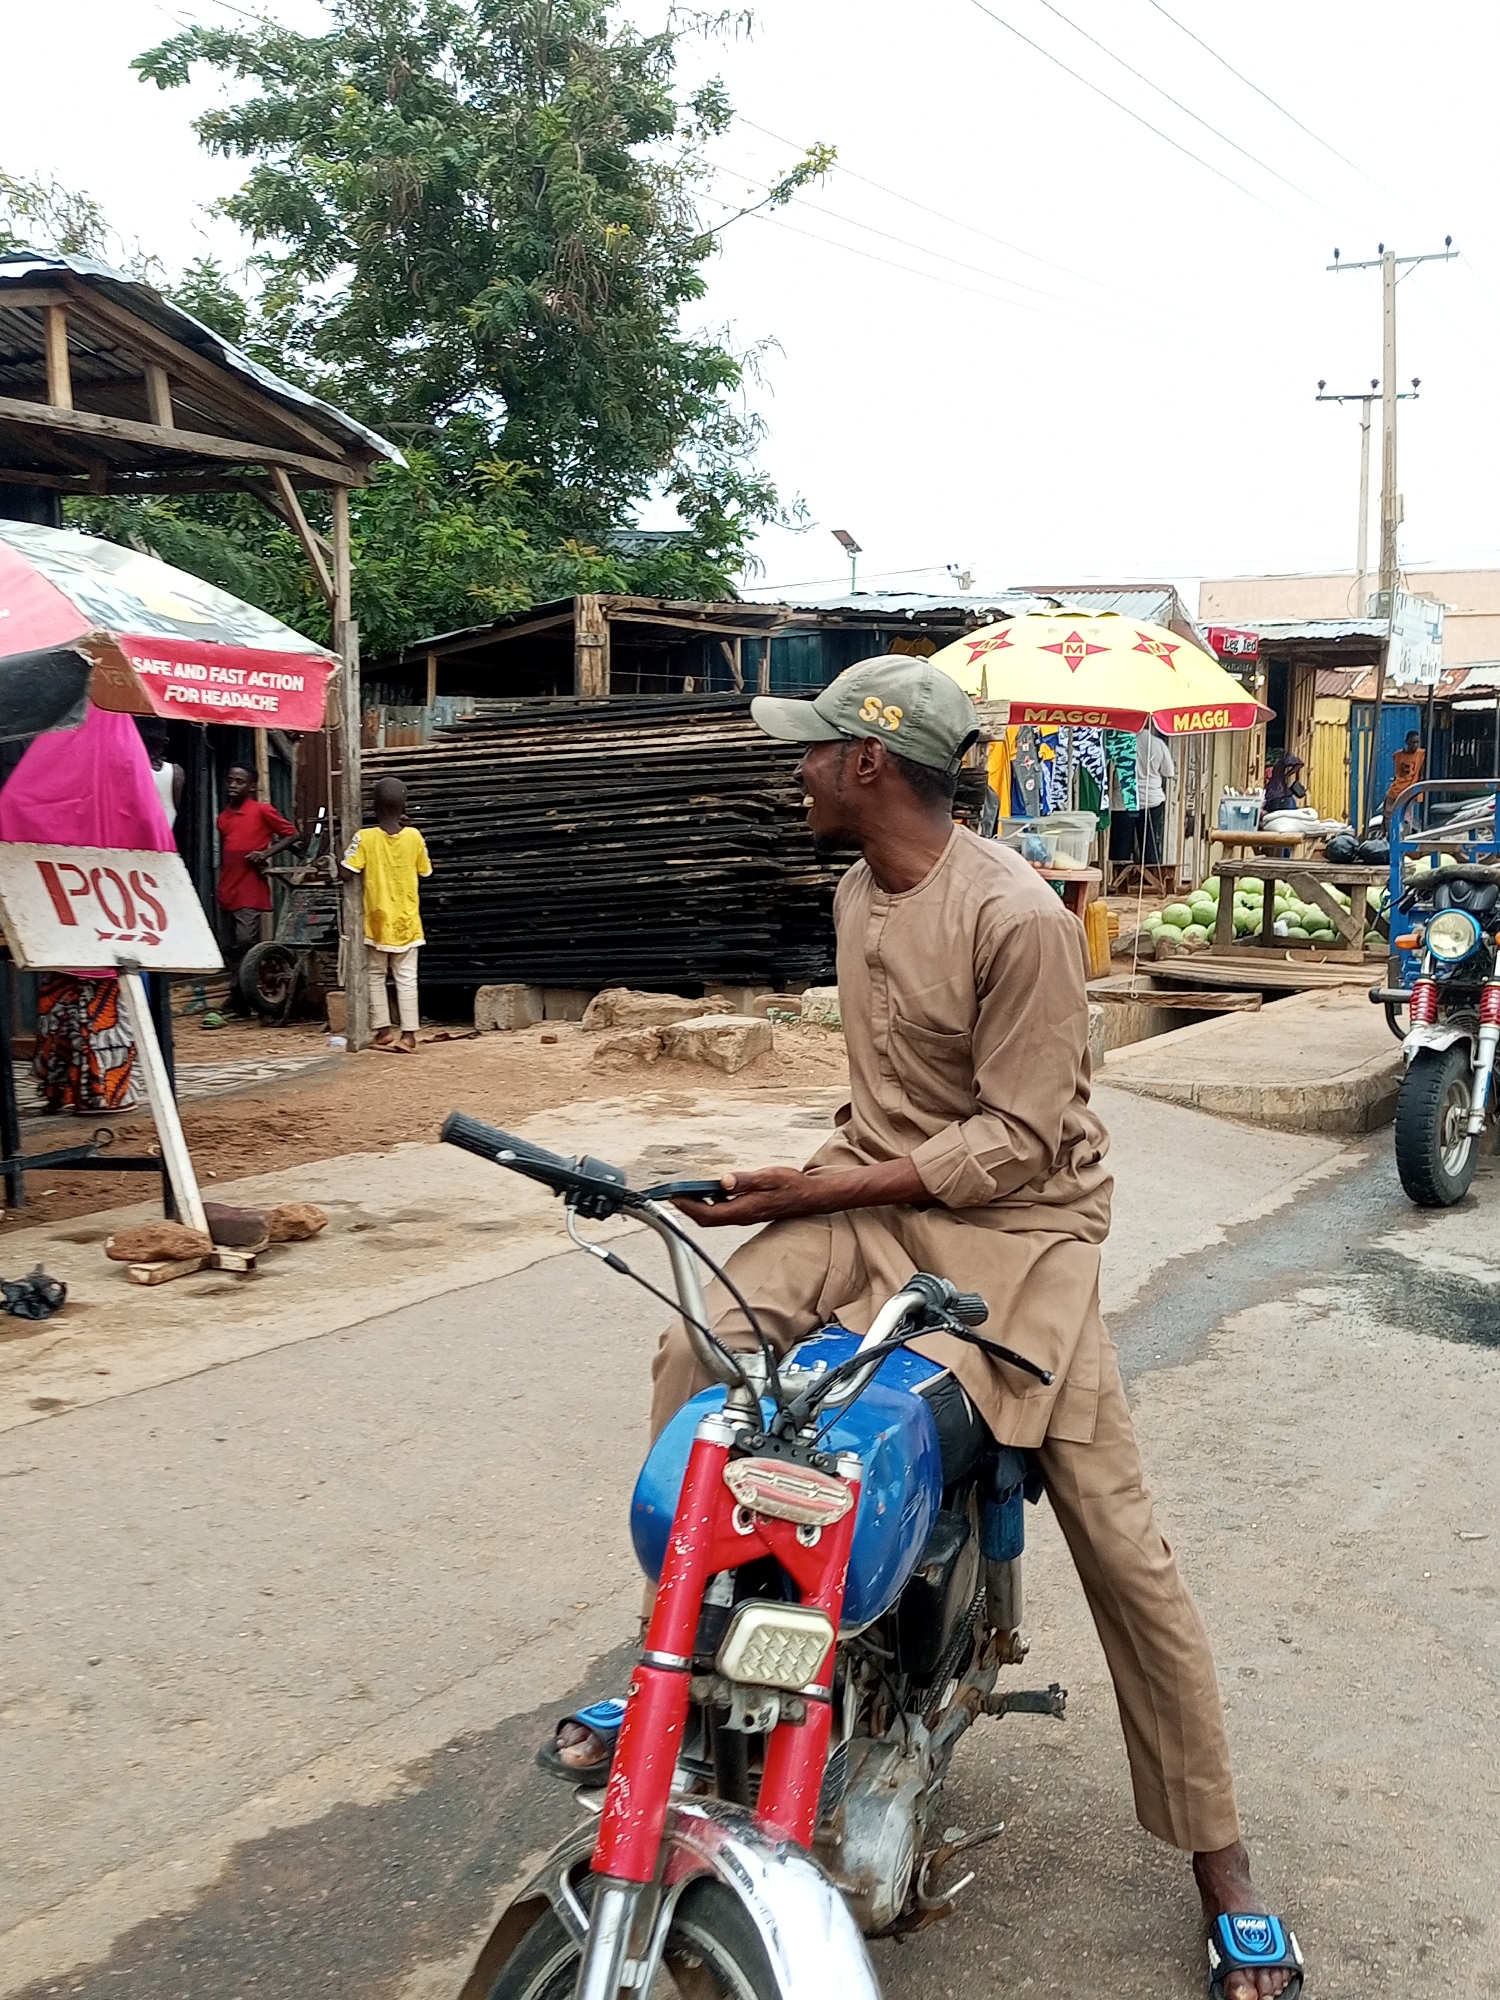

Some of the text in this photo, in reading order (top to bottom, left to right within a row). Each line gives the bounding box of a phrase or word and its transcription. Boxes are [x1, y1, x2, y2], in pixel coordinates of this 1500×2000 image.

[1065, 645, 1083, 655] M
[1148, 642, 1166, 655] M
[131, 656, 305, 692] SAFE AND FAST ACTION
[164, 684, 280, 713] FOR HEADACHE
[35, 861, 168, 932] POS
